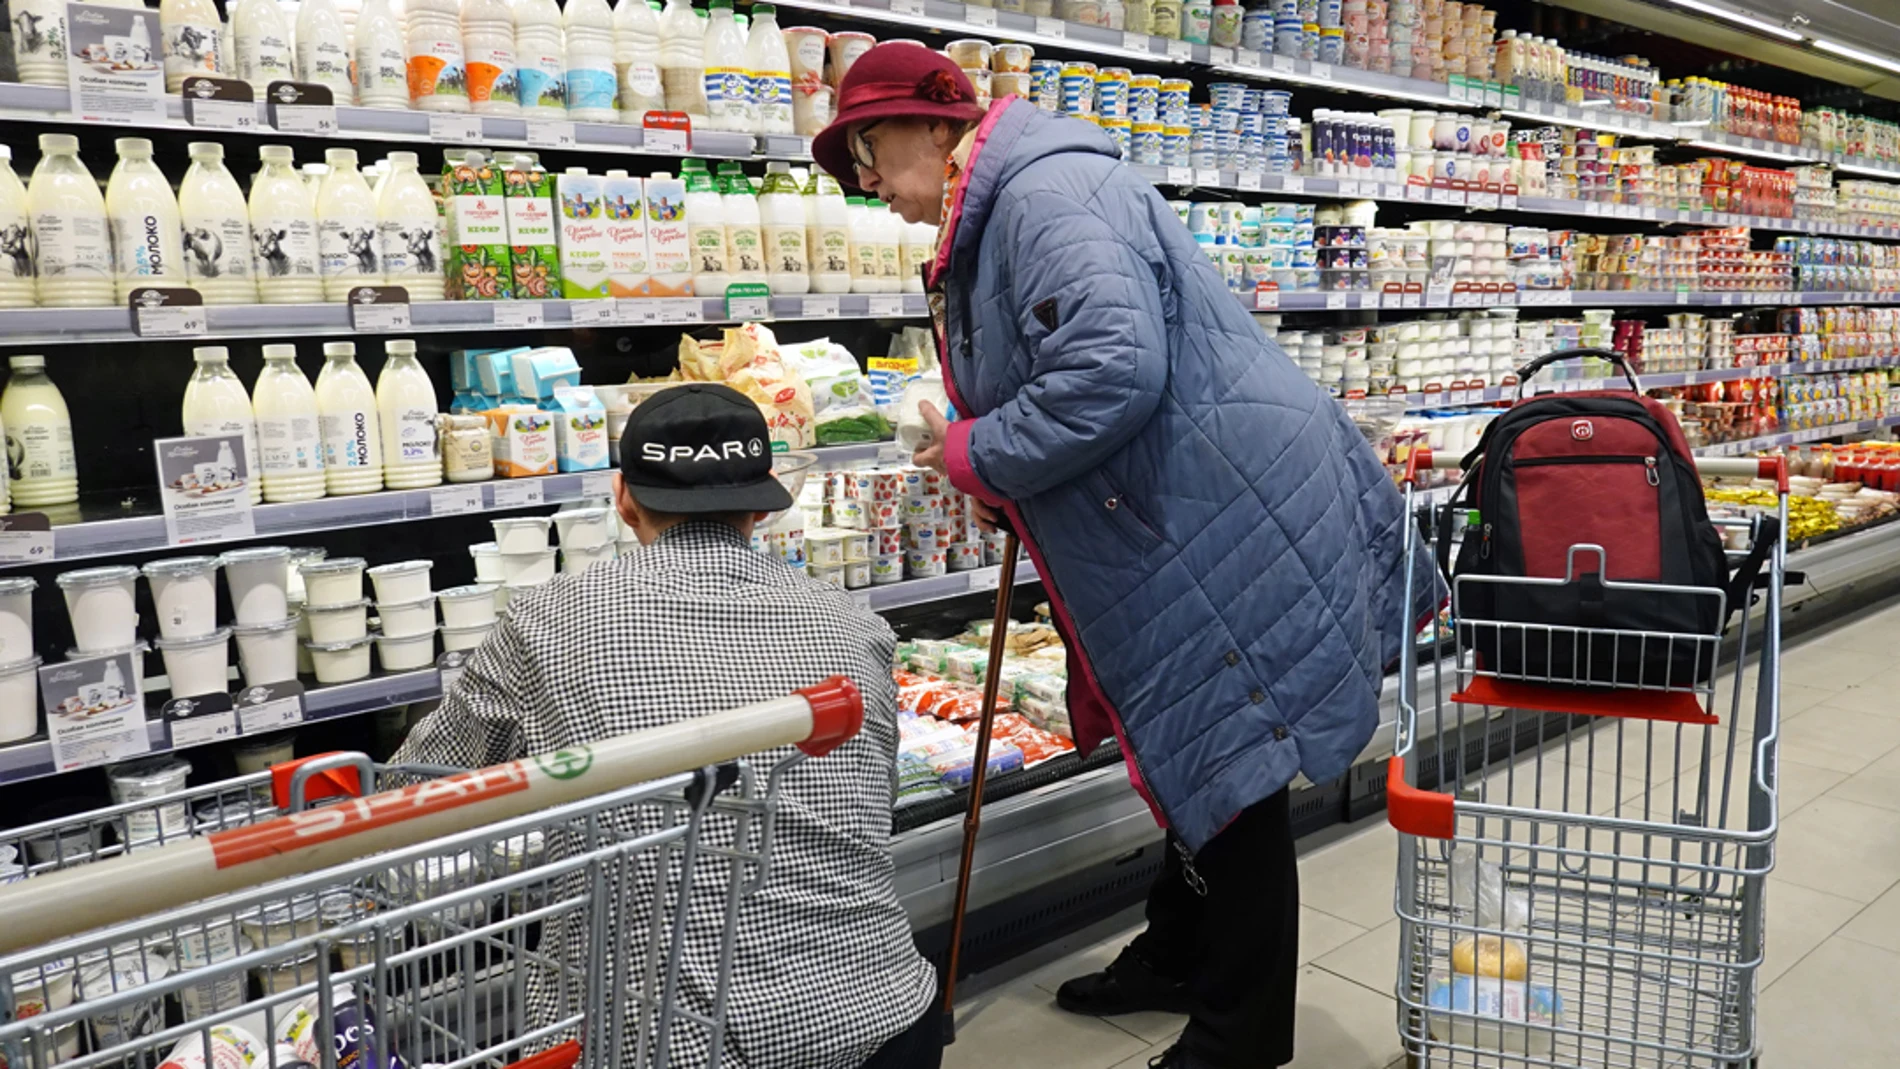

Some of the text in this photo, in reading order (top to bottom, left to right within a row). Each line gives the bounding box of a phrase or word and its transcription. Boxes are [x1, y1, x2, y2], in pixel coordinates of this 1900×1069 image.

[237, 117, 250, 125] 55
[144, 215, 163, 275] МОЛОКО
[184, 321, 197, 329] 69
[354, 412, 368, 466] МОЛОКО
[642, 440, 747, 463] SPAR
[29, 546, 44, 555] 69
